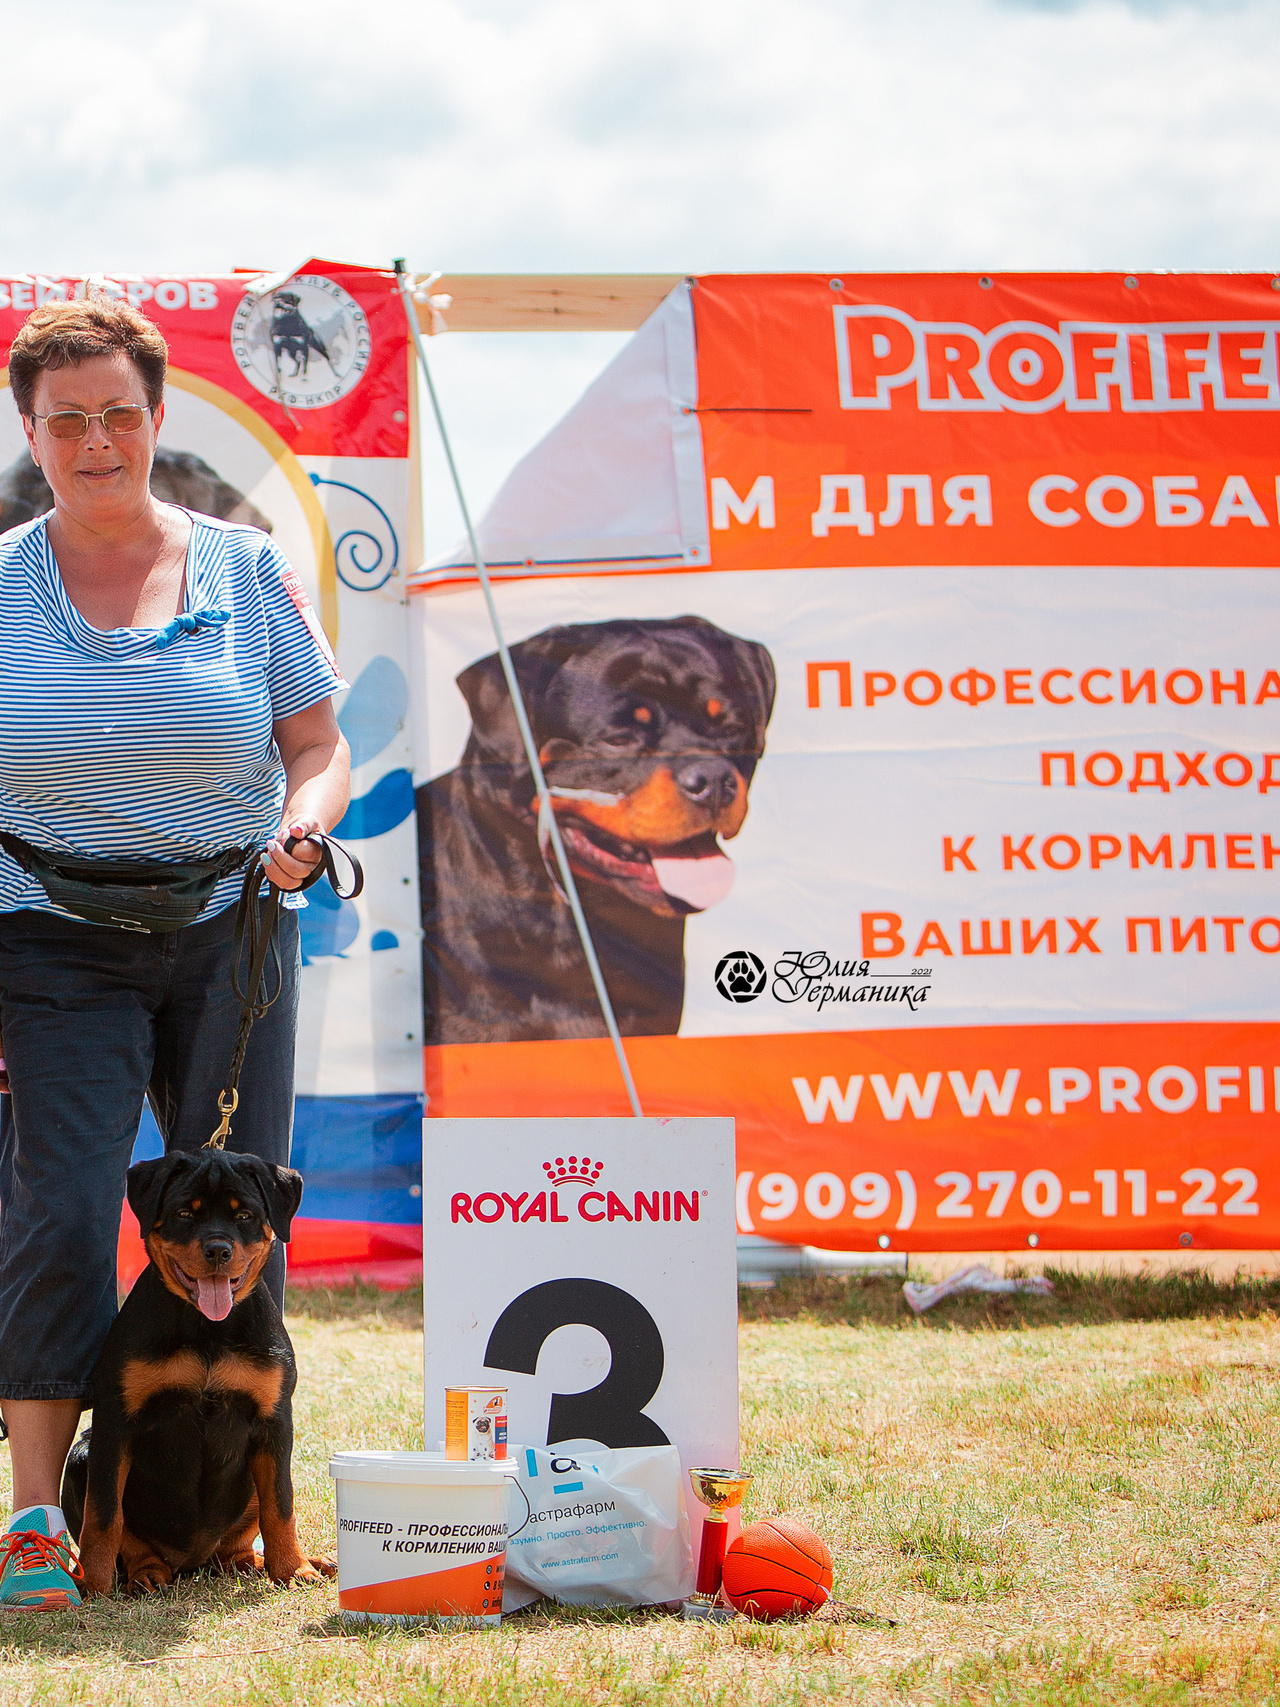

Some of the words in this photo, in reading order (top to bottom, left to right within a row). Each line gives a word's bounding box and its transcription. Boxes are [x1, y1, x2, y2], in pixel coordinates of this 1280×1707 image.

[294, 275, 344, 298] КЛУБ
[832, 304, 1280, 414] PROFIFE
[811, 474, 993, 537] ДЛЯ
[1027, 473, 1280, 528] СОБА
[942, 834, 978, 872] К
[451, 1191, 569, 1224] ROYAL
[577, 1190, 700, 1223] CANIN
[735, 1170, 918, 1232] (909)
[933, 1167, 1260, 1219] 270-11-22
[483, 1277, 670, 1447] 3
[339, 1518, 393, 1535] PROFIFEED
[529, 1500, 616, 1524] астрафарм
[382, 1540, 393, 1552] К
[395, 1541, 485, 1554] КОРМЛЕНИЮ
[509, 1534, 545, 1546] азумно.
[546, 1529, 584, 1541] Просто.
[585, 1519, 648, 1535] Эффективно.
[540, 1552, 619, 1569] www.astrafarm.com
